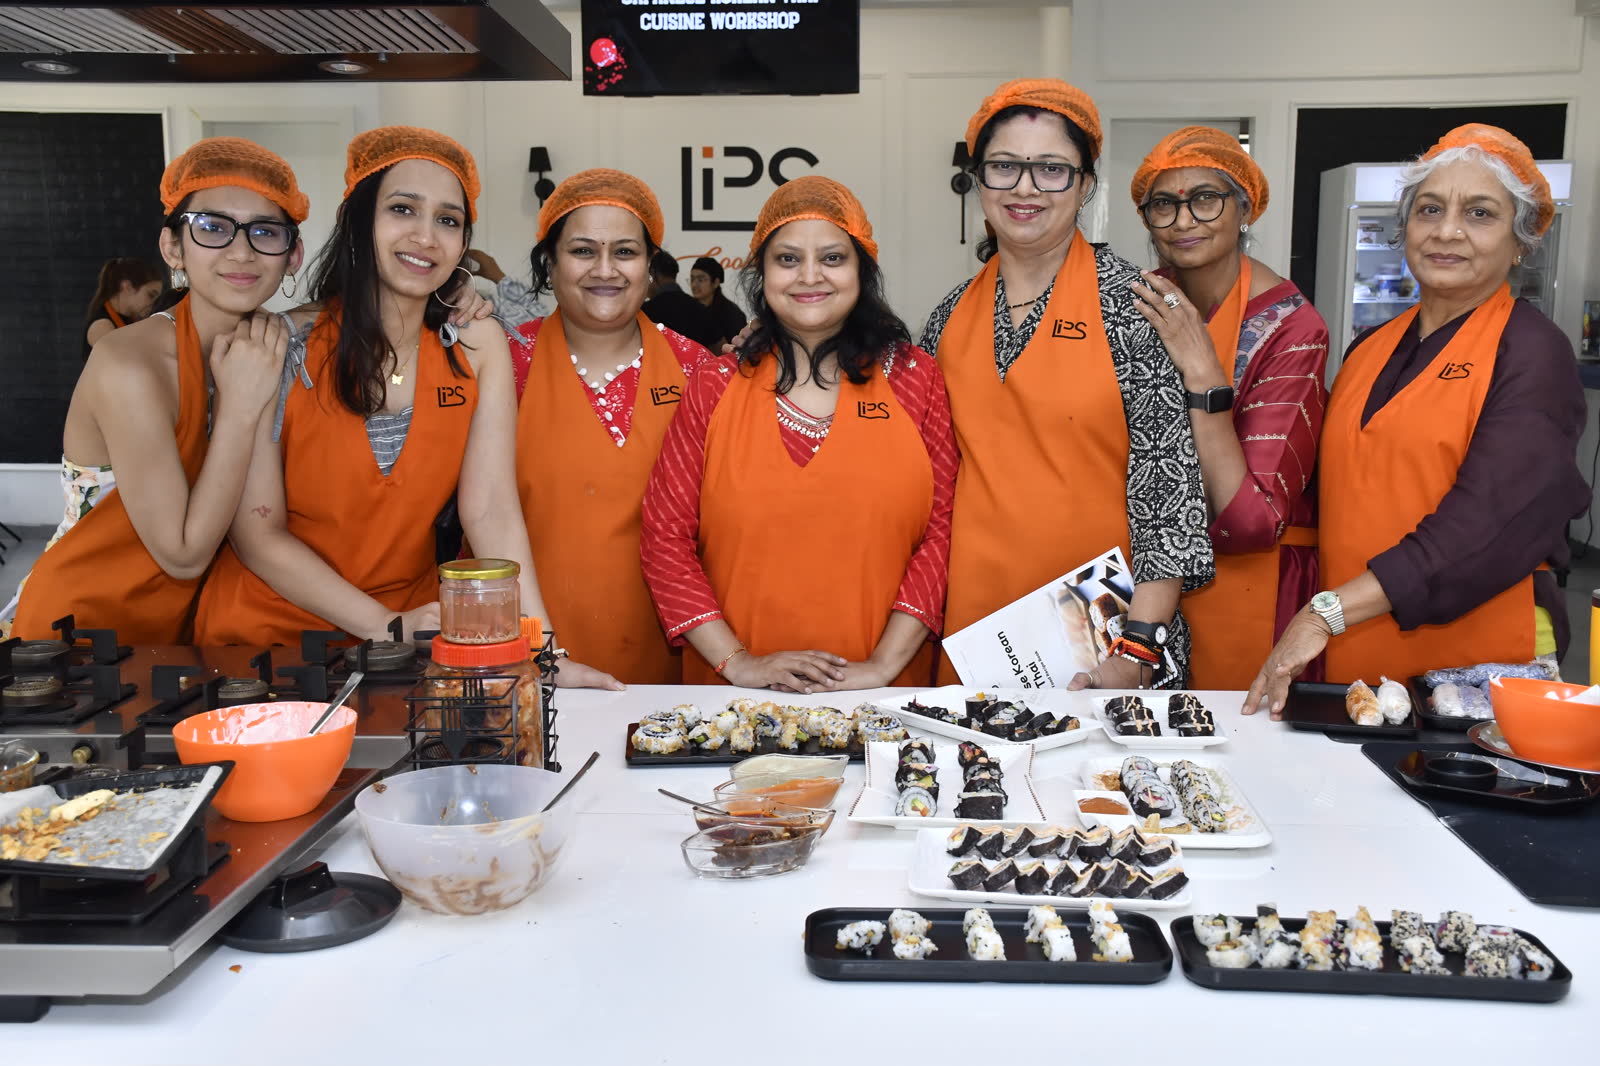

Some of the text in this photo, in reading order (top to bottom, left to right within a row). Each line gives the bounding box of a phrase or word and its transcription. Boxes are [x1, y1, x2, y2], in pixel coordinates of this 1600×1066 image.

[640, 12, 800, 30] CUISINE WORKSHOP
[997, 631, 1024, 676] Korean
[1025, 661, 1046, 689] Thai
